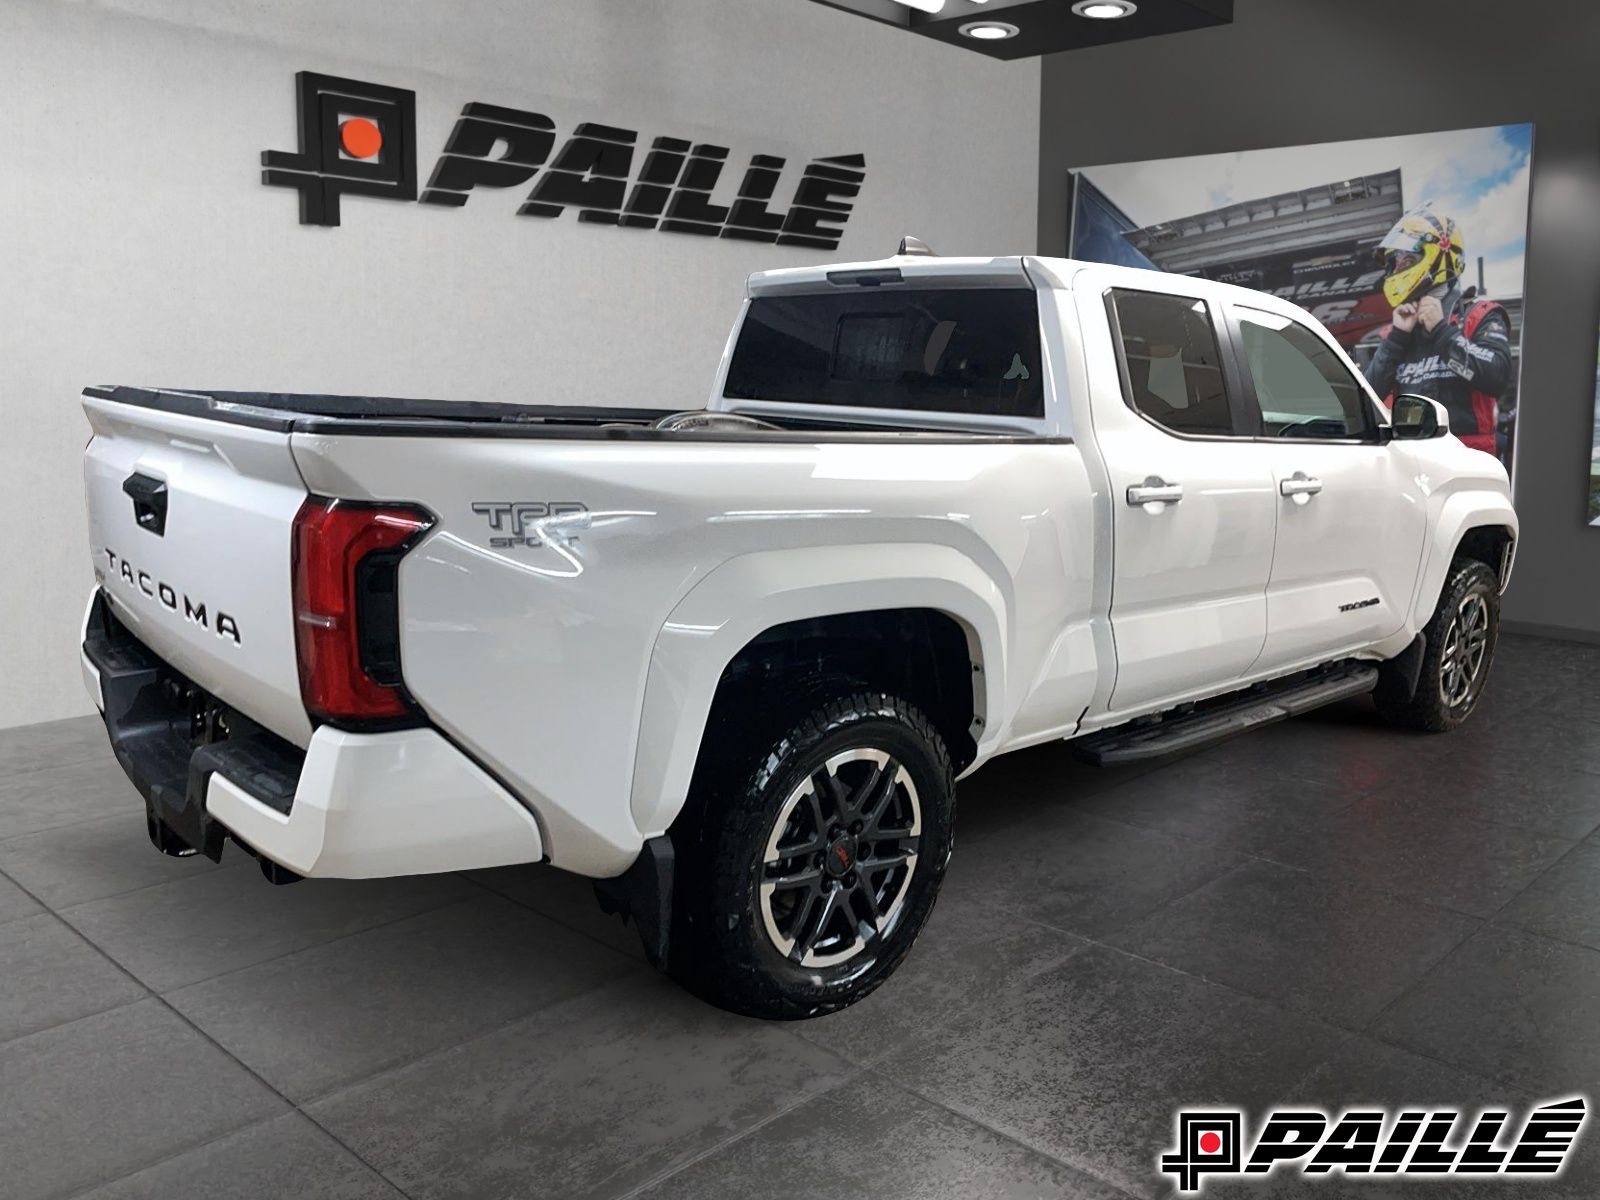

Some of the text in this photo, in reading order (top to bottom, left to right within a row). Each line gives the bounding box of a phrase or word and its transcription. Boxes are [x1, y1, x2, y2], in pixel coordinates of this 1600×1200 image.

[419, 100, 866, 251] PAILLÉ
[1294, 260, 1356, 275] CHEVROLET
[1297, 286, 1374, 300] CANADA
[104, 547, 242, 643] TACOMA
